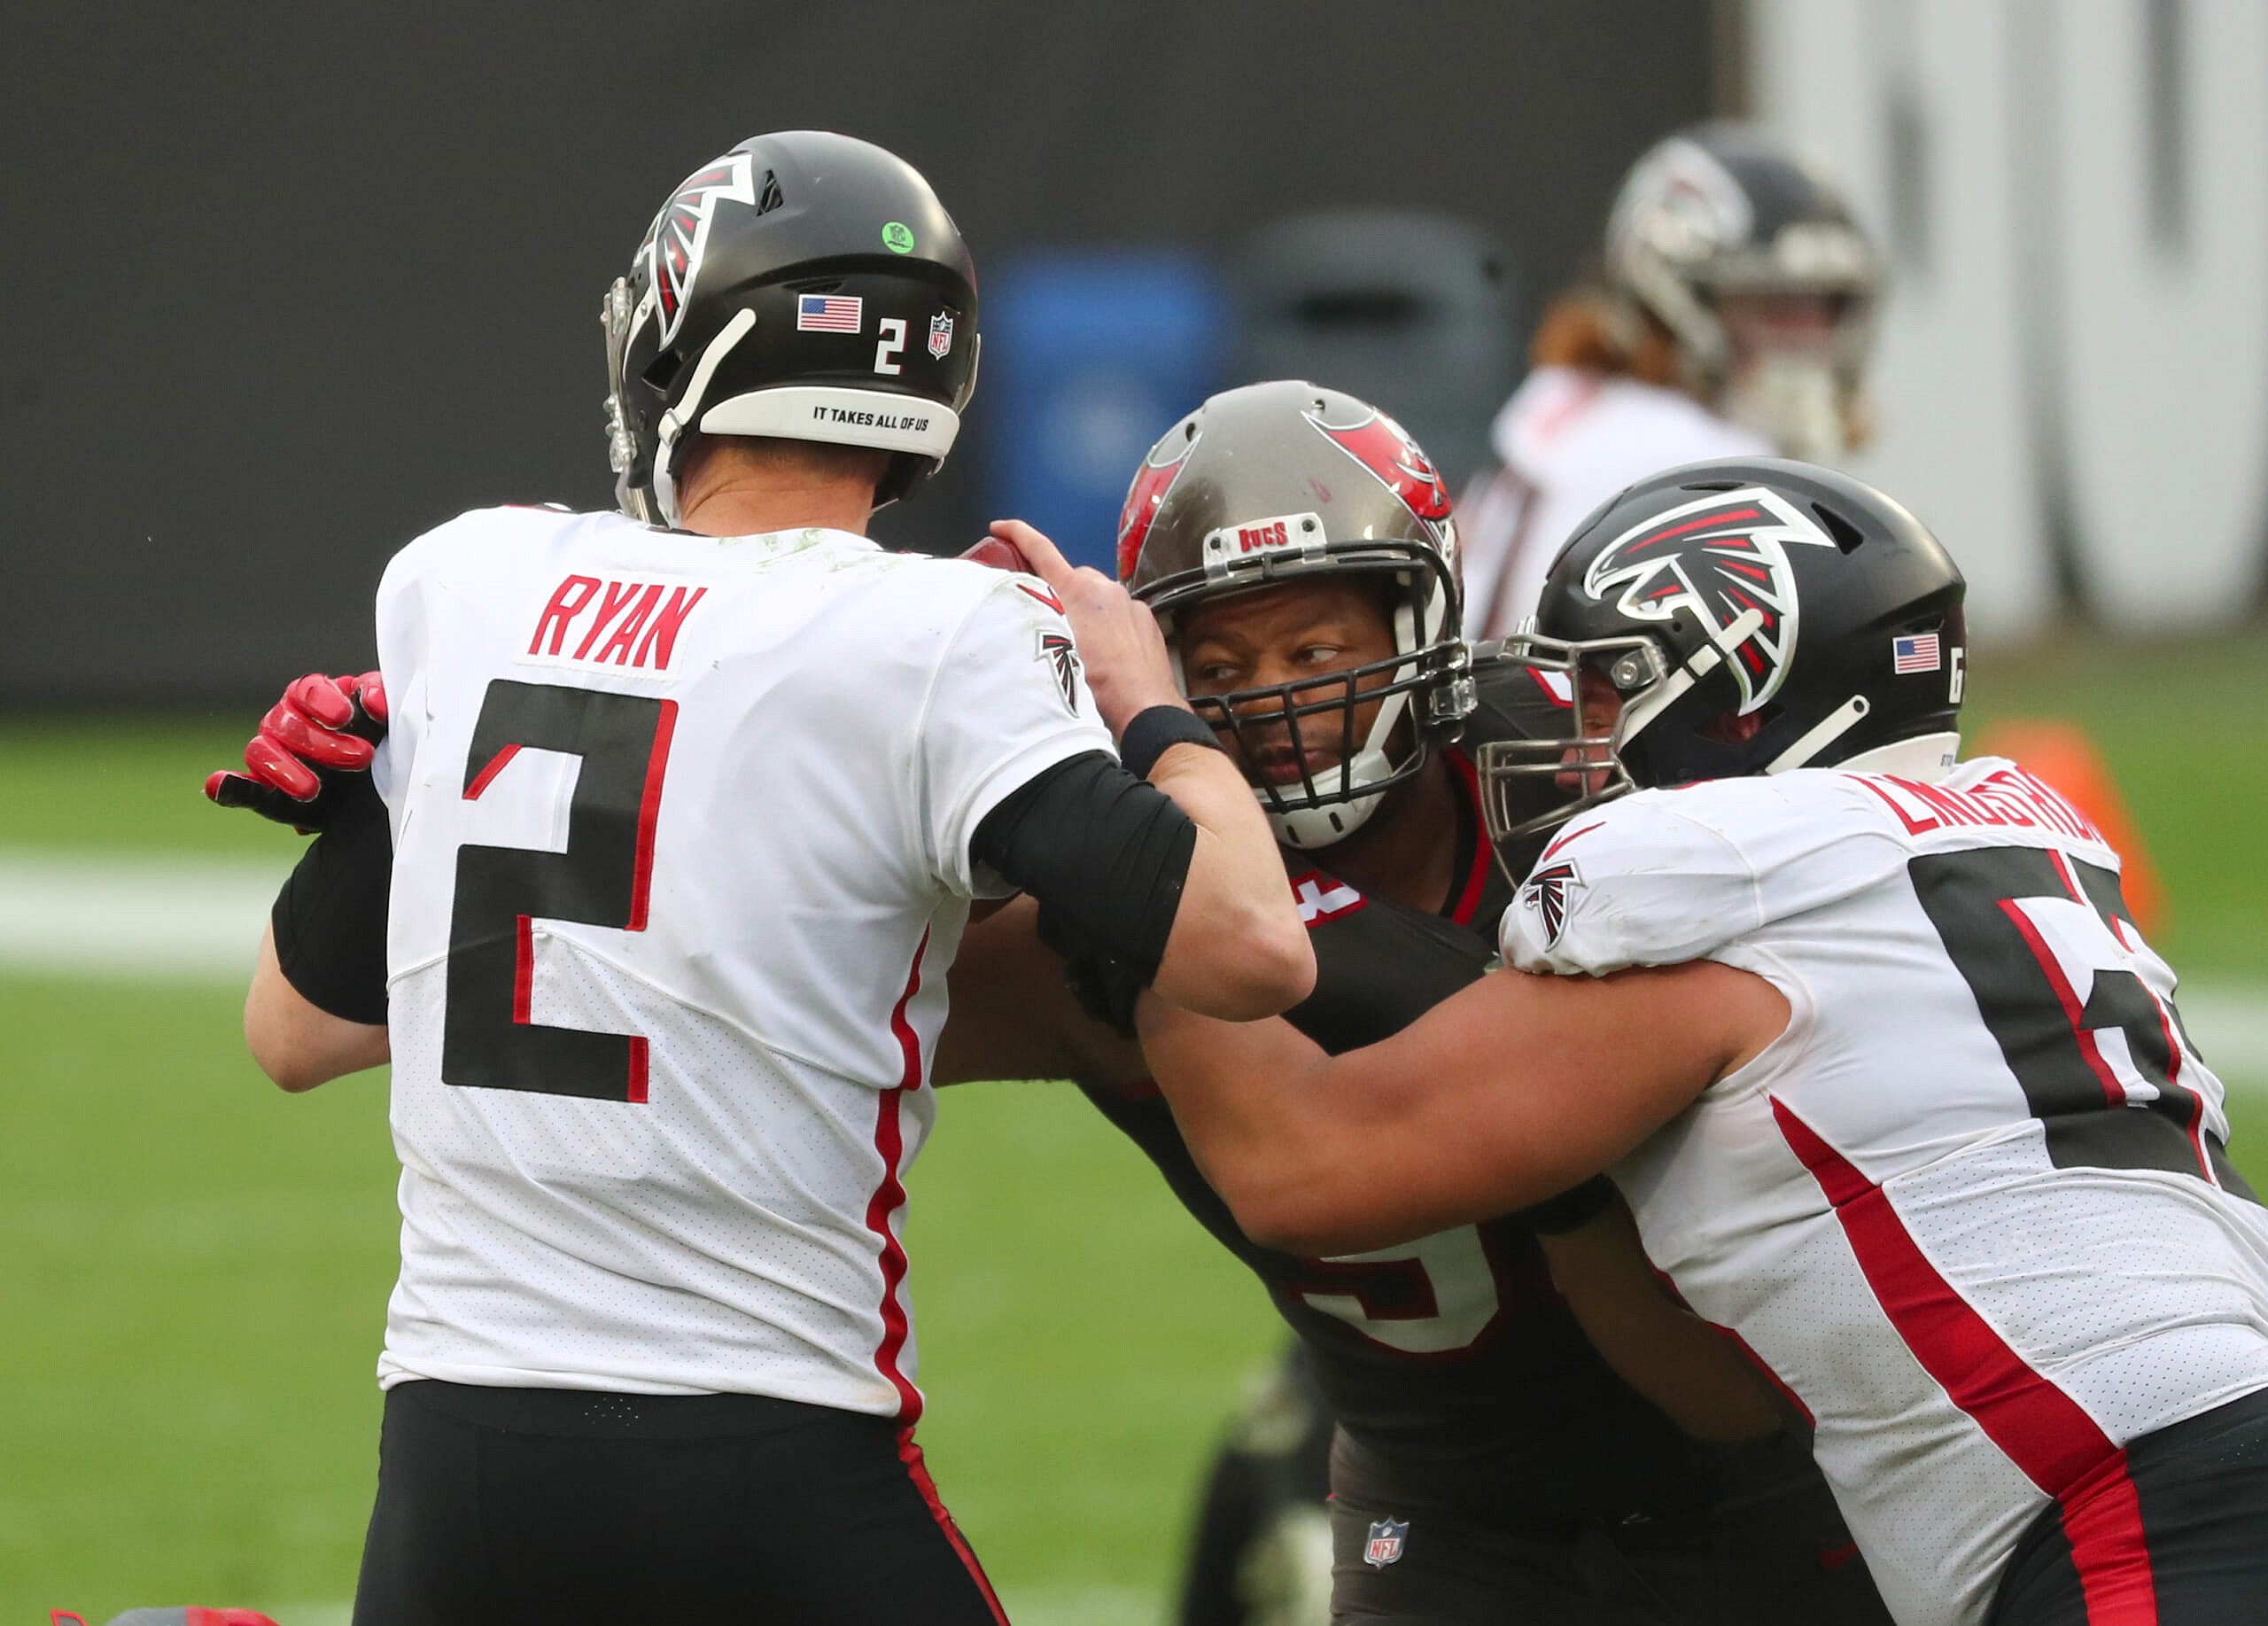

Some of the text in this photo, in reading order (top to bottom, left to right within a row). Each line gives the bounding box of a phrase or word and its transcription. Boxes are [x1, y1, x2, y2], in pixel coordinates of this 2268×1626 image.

[874, 317, 910, 376] 2
[931, 332, 948, 352] NFL
[813, 406, 929, 432] IT TAKES ALL OF US
[528, 574, 708, 671] RYAN
[441, 678, 680, 1104] 2
[1907, 844, 2267, 1207] 6
[1370, 1539, 1397, 1560] NFL
